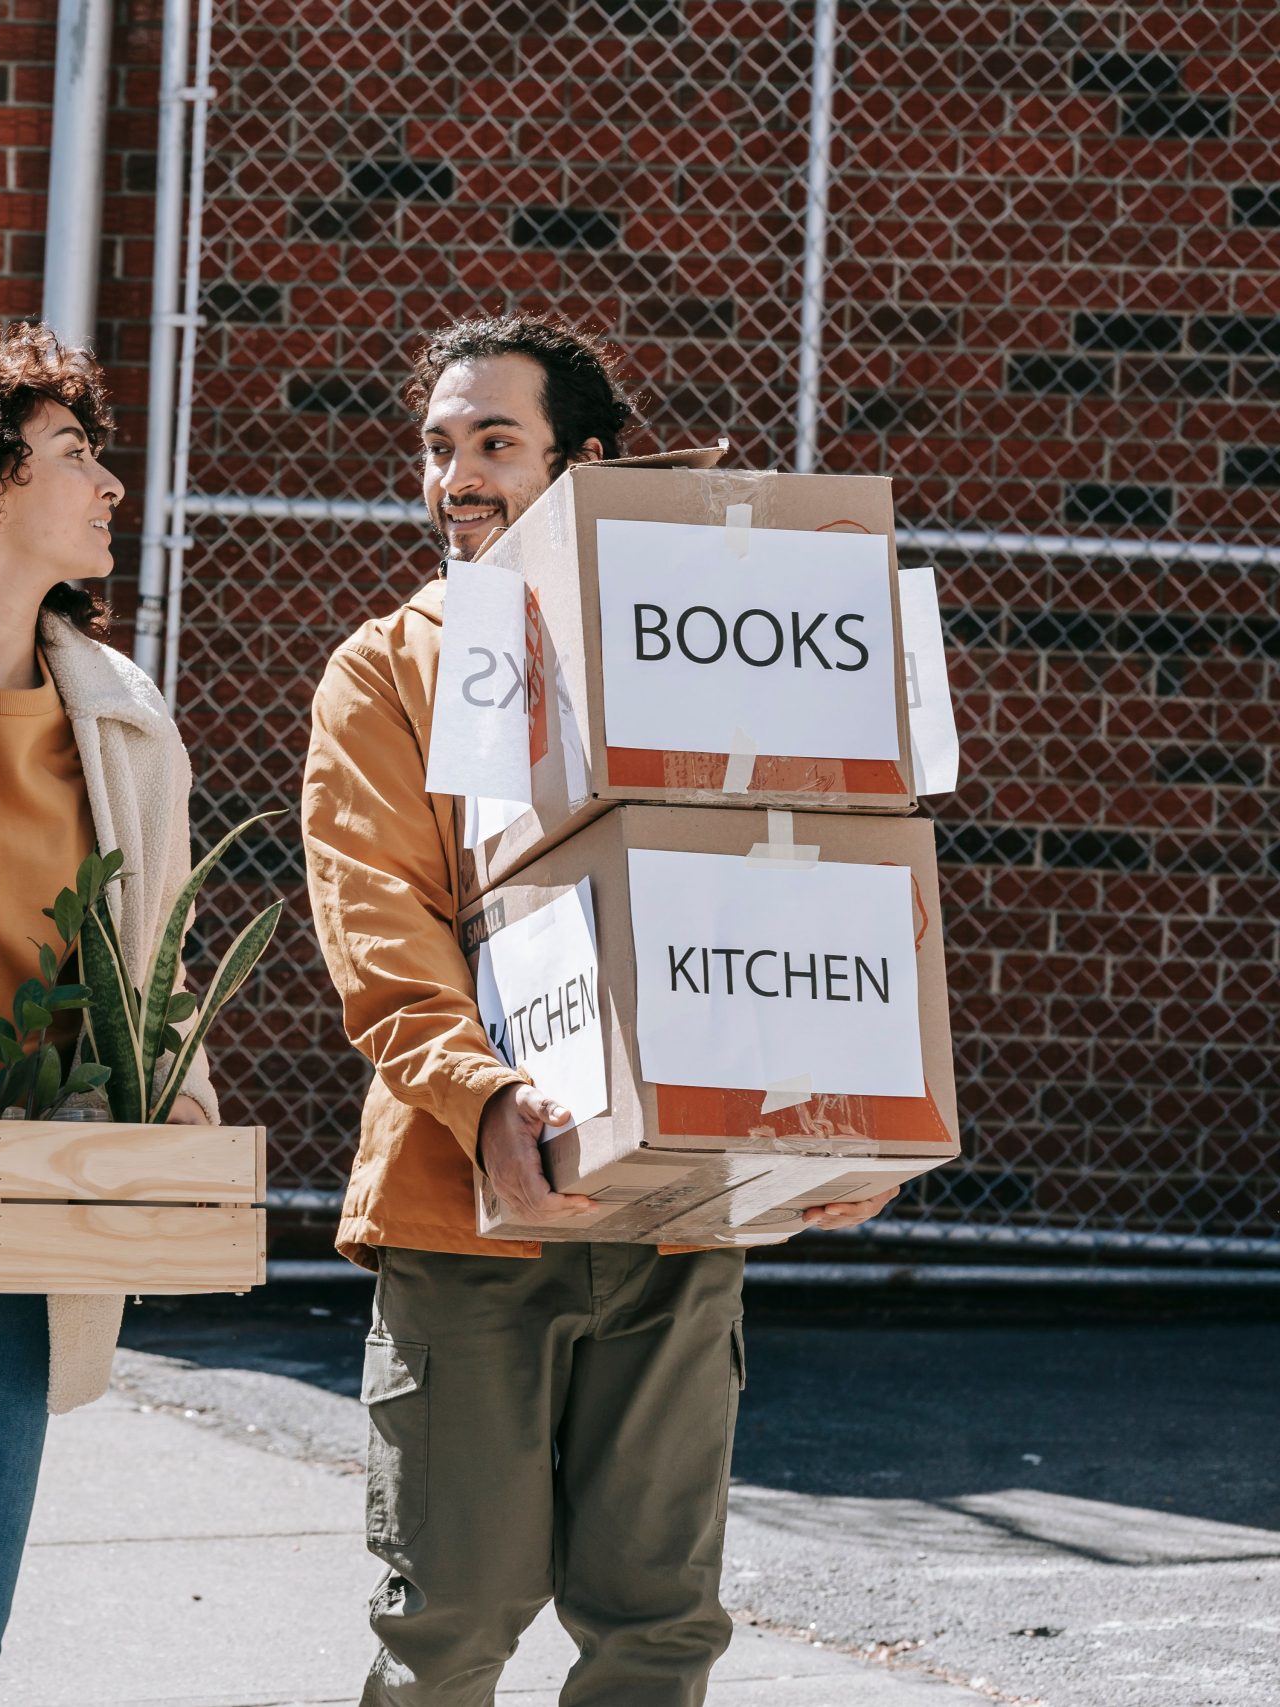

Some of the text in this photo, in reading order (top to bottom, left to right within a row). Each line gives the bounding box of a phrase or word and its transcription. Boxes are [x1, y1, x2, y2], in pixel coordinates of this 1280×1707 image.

[634, 603, 869, 671] BOOKS
[466, 907, 503, 948] SMALL
[668, 945, 889, 1004] KITCHEN
[489, 967, 596, 1068] KITCHEN
